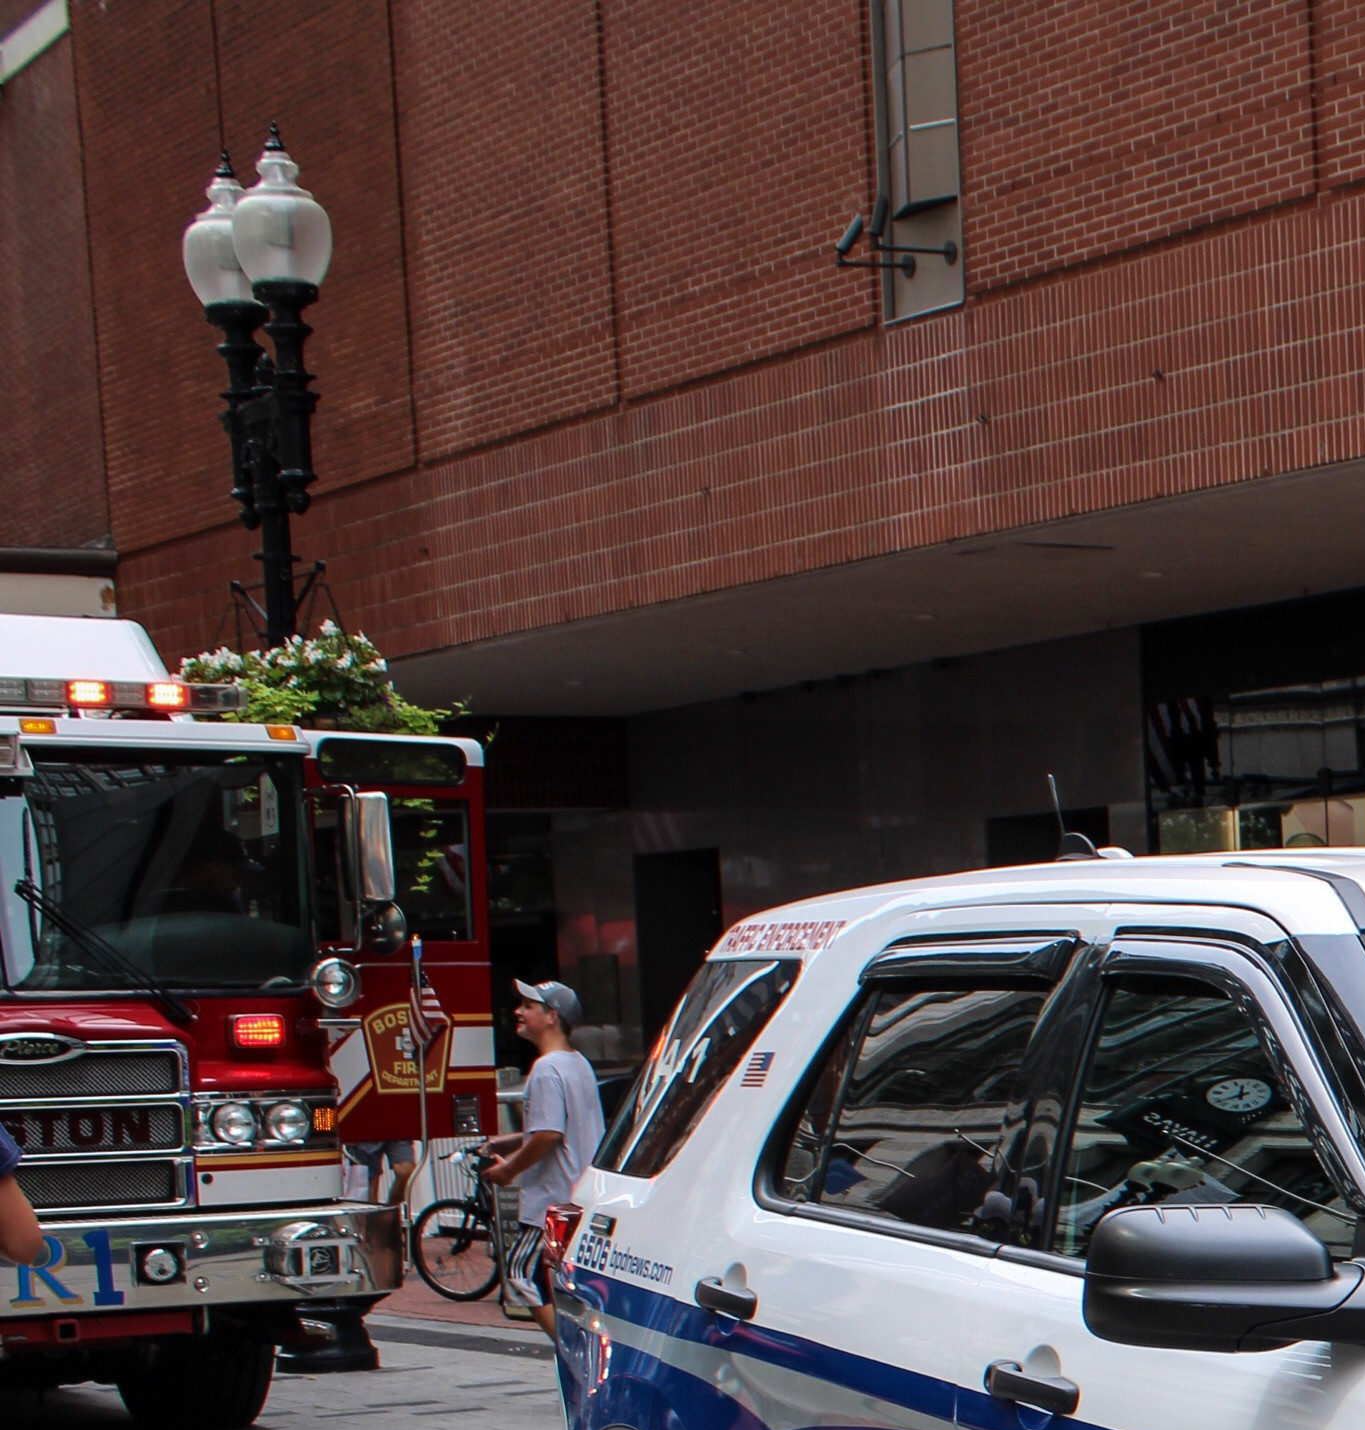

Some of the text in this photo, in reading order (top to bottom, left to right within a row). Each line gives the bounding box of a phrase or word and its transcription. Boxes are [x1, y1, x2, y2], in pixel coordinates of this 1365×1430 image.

[2, 1039, 59, 1058] Pierce
[394, 1061, 416, 1074] FIR
[577, 1233, 674, 1286] 6506 bpdnews.com
